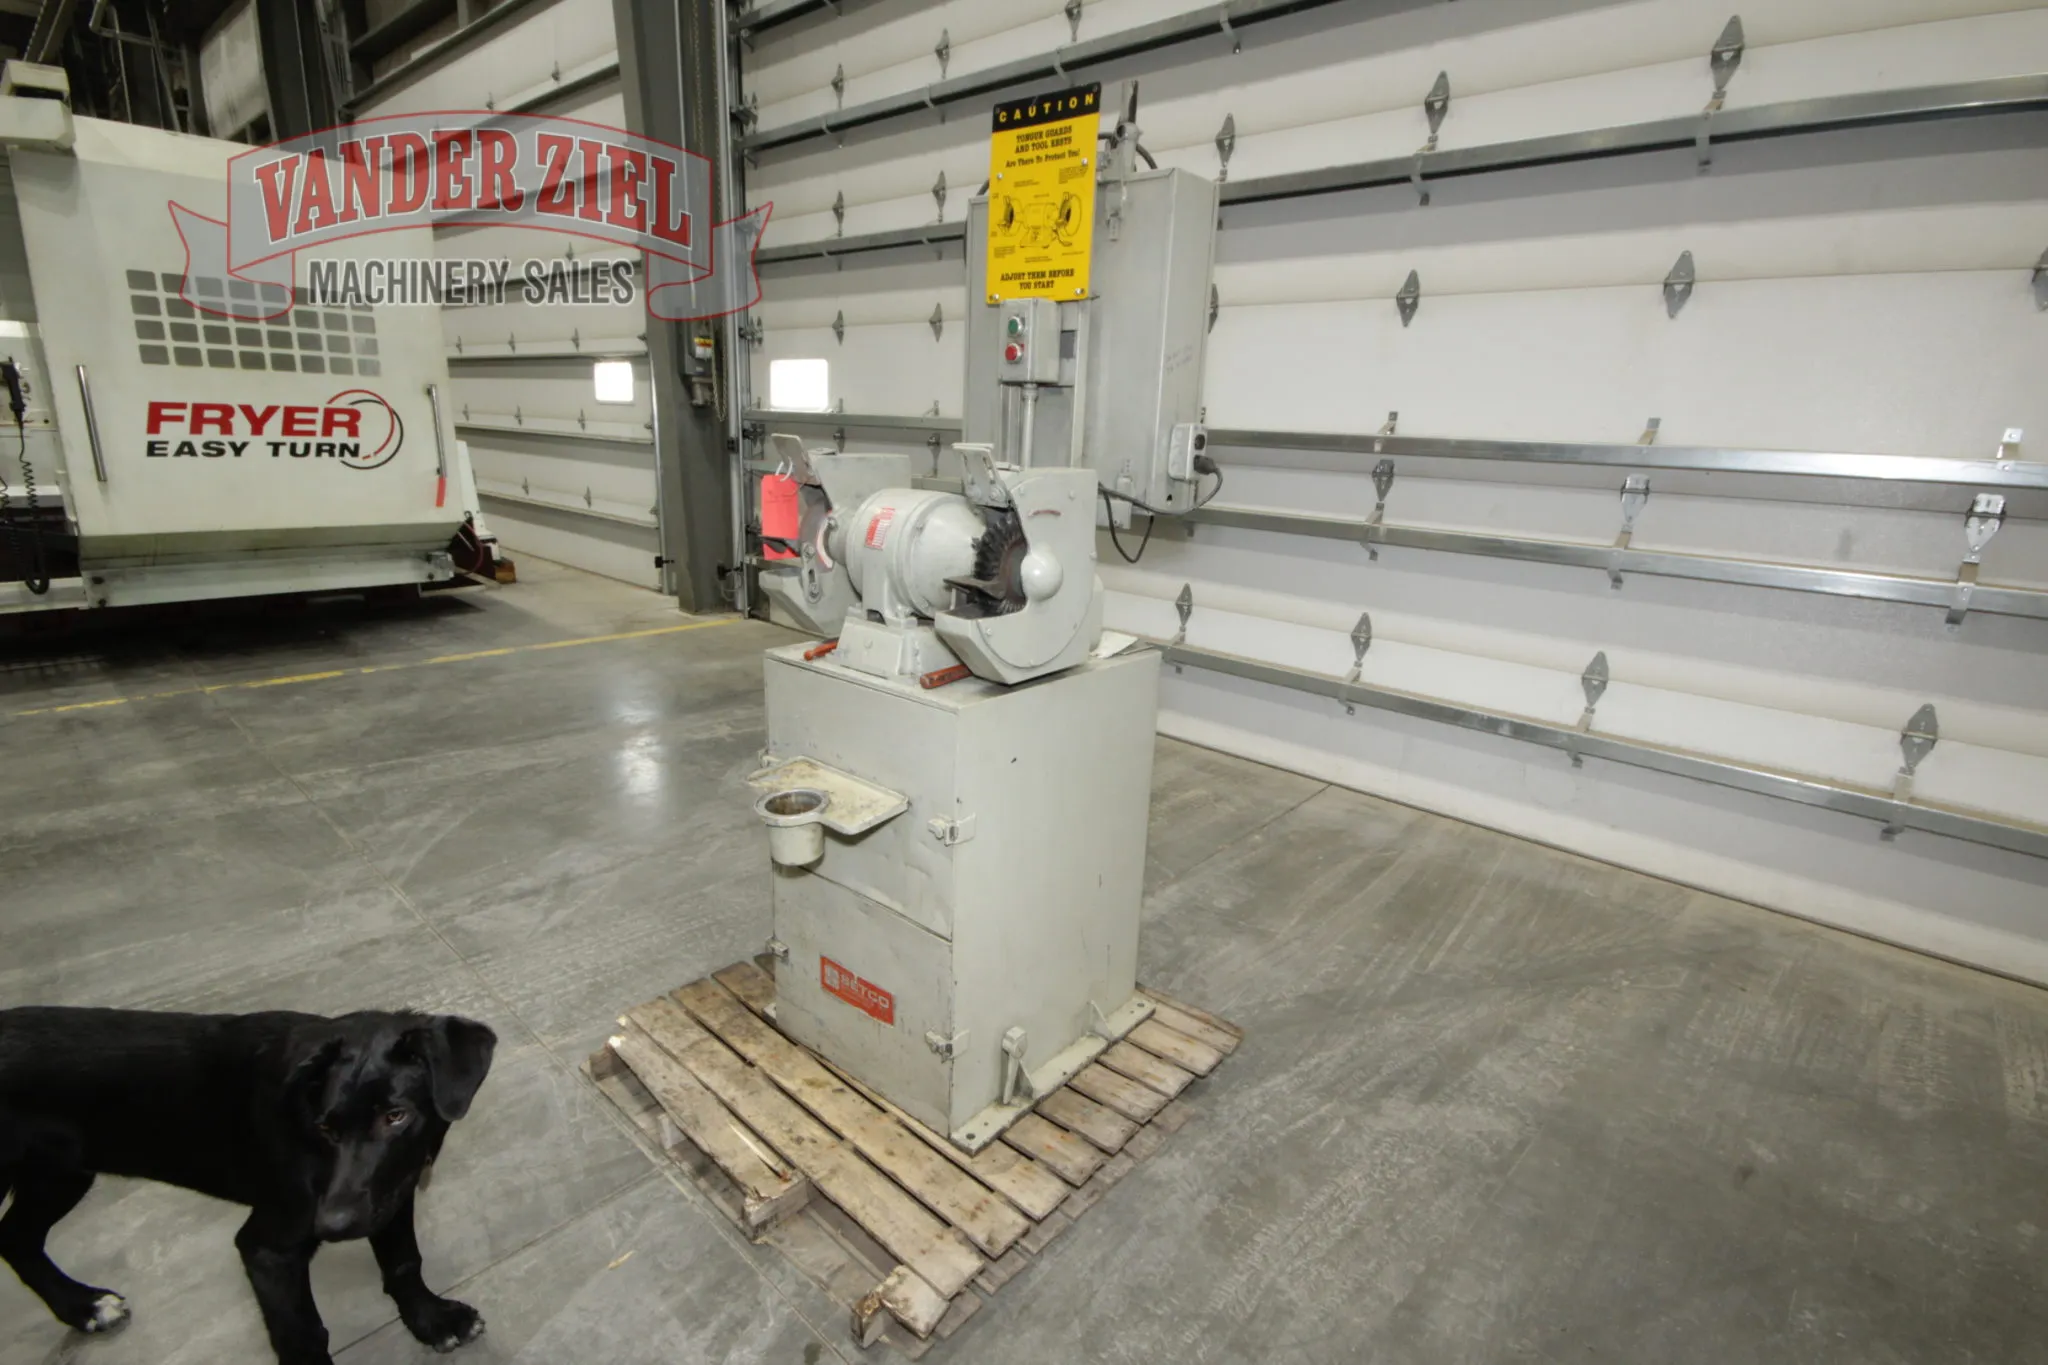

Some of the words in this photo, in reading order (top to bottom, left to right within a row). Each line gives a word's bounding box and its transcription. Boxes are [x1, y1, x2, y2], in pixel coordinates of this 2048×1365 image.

[999, 93, 1094, 122] CAUTION
[1016, 130, 1043, 143] TONGUE
[1045, 125, 1072, 138] GUARDS
[1015, 144, 1029, 154] AND
[1031, 140, 1048, 152] TOOL
[1050, 136, 1072, 148] RESTS
[1005, 159, 1016, 168] Are
[1018, 157, 1034, 167] There
[1045, 151, 1066, 161] Protect
[1000, 272, 1026, 281] ADJUST
[1027, 271, 1046, 280] THEM
[1048, 268, 1074, 279] BEFORE
[1020, 281, 1031, 290] YOU
[1033, 280, 1054, 289] START
[146, 401, 362, 438] FRYER
[147, 440, 250, 458] EASY
[266, 442, 360, 458] TURN
